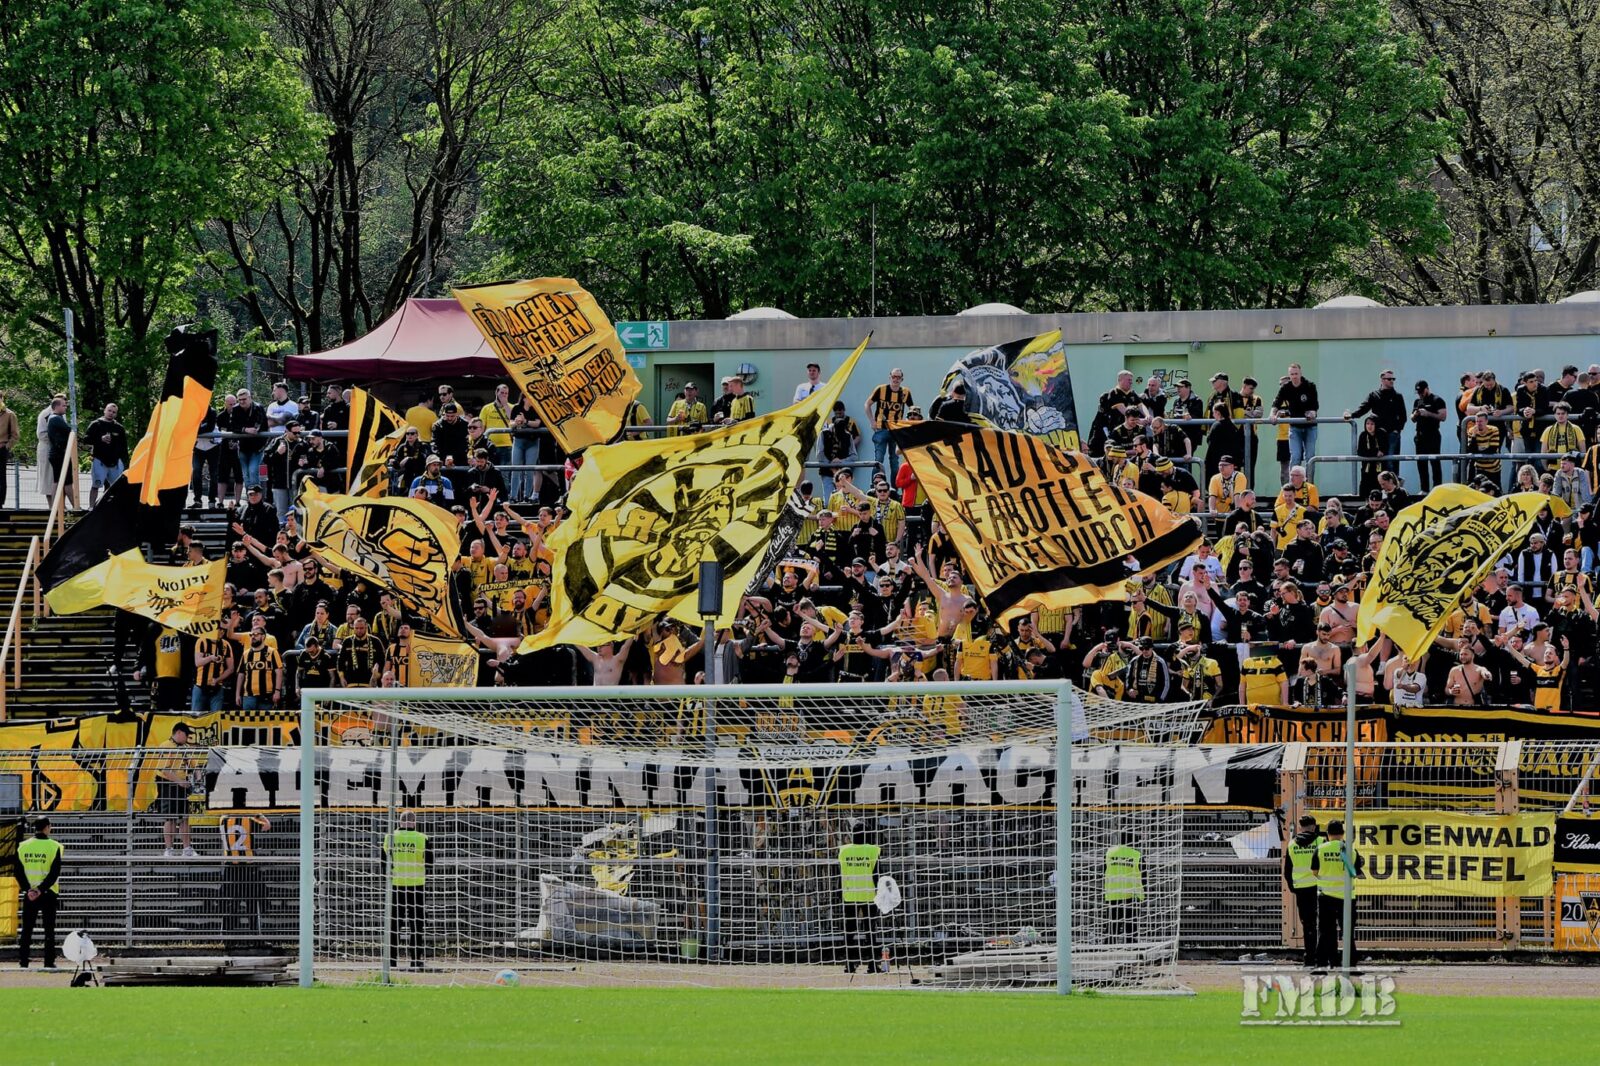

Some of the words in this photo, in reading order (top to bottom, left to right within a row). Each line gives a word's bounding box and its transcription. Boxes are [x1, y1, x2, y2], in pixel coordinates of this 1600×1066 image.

[527, 311, 595, 359] GEBEN
[1055, 504, 1155, 569] DURCH
[1223, 716, 1379, 742] FREUNDSCHFT
[207, 746, 750, 808] ALEMANNIA
[855, 744, 1230, 804] AACHEN
[1562, 904, 1583, 921] 20
